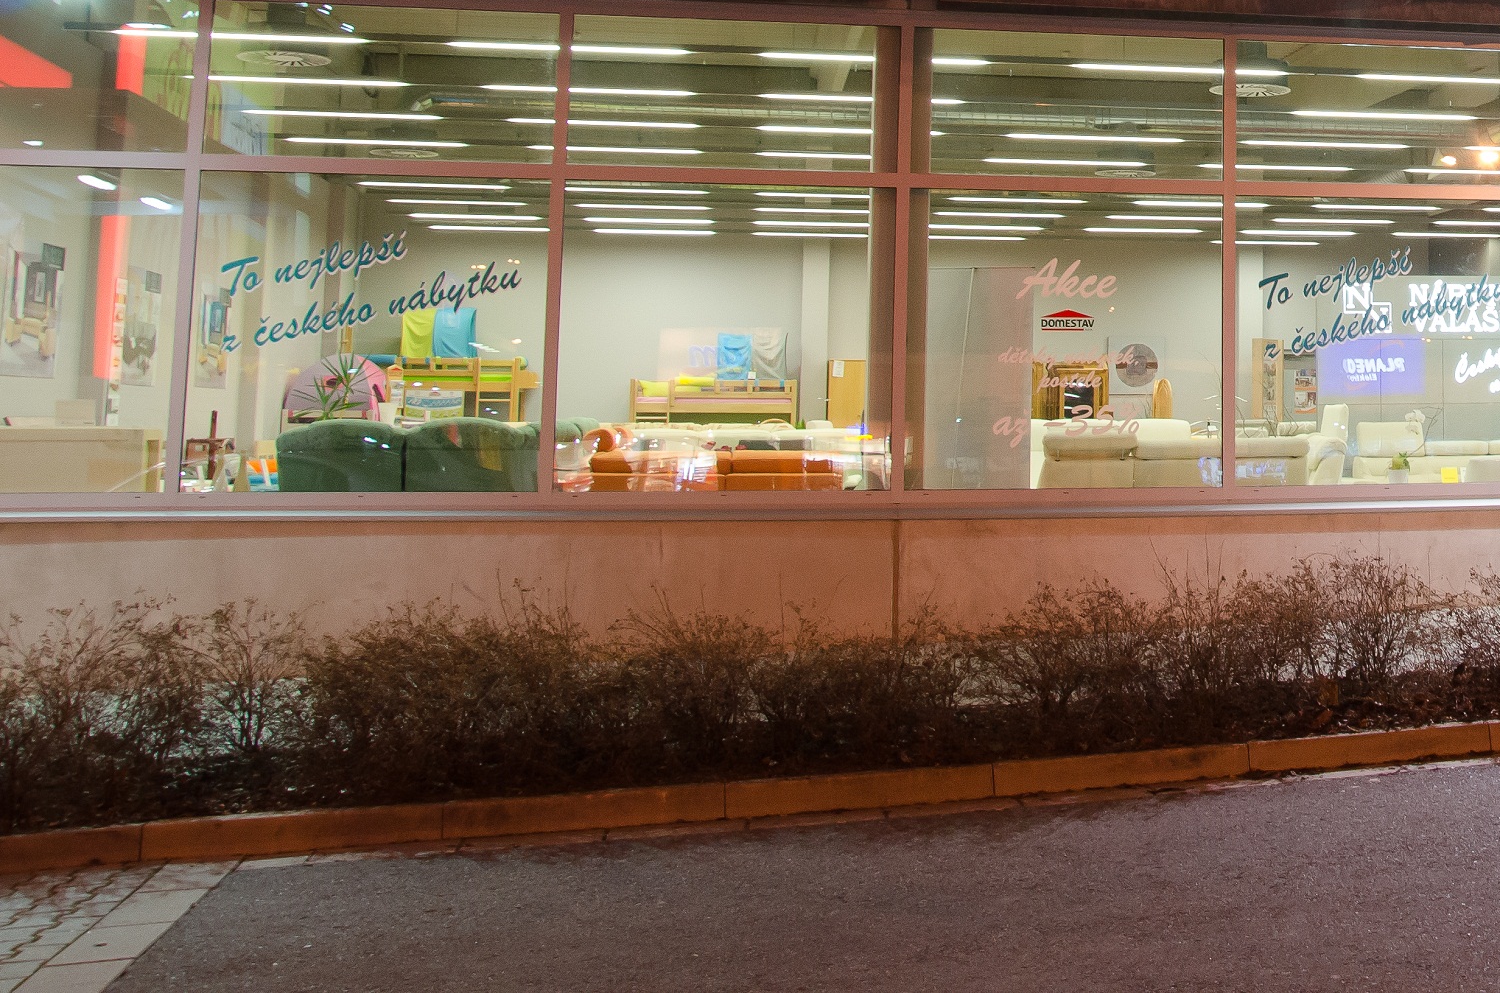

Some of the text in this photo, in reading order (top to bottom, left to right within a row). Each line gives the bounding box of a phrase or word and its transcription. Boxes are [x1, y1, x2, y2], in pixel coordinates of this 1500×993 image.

[221, 231, 409, 297] To nejlepší
[1016, 257, 1118, 300] Akce
[1259, 246, 1413, 310] To nejlepší
[221, 261, 523, 353] z českého nábytku
[1041, 318, 1095, 329] DOMESTAV
[1264, 343, 1281, 359] z
[1291, 306, 1391, 356] českého
[1037, 371, 1103, 394] postele
[992, 408, 1034, 449] až
